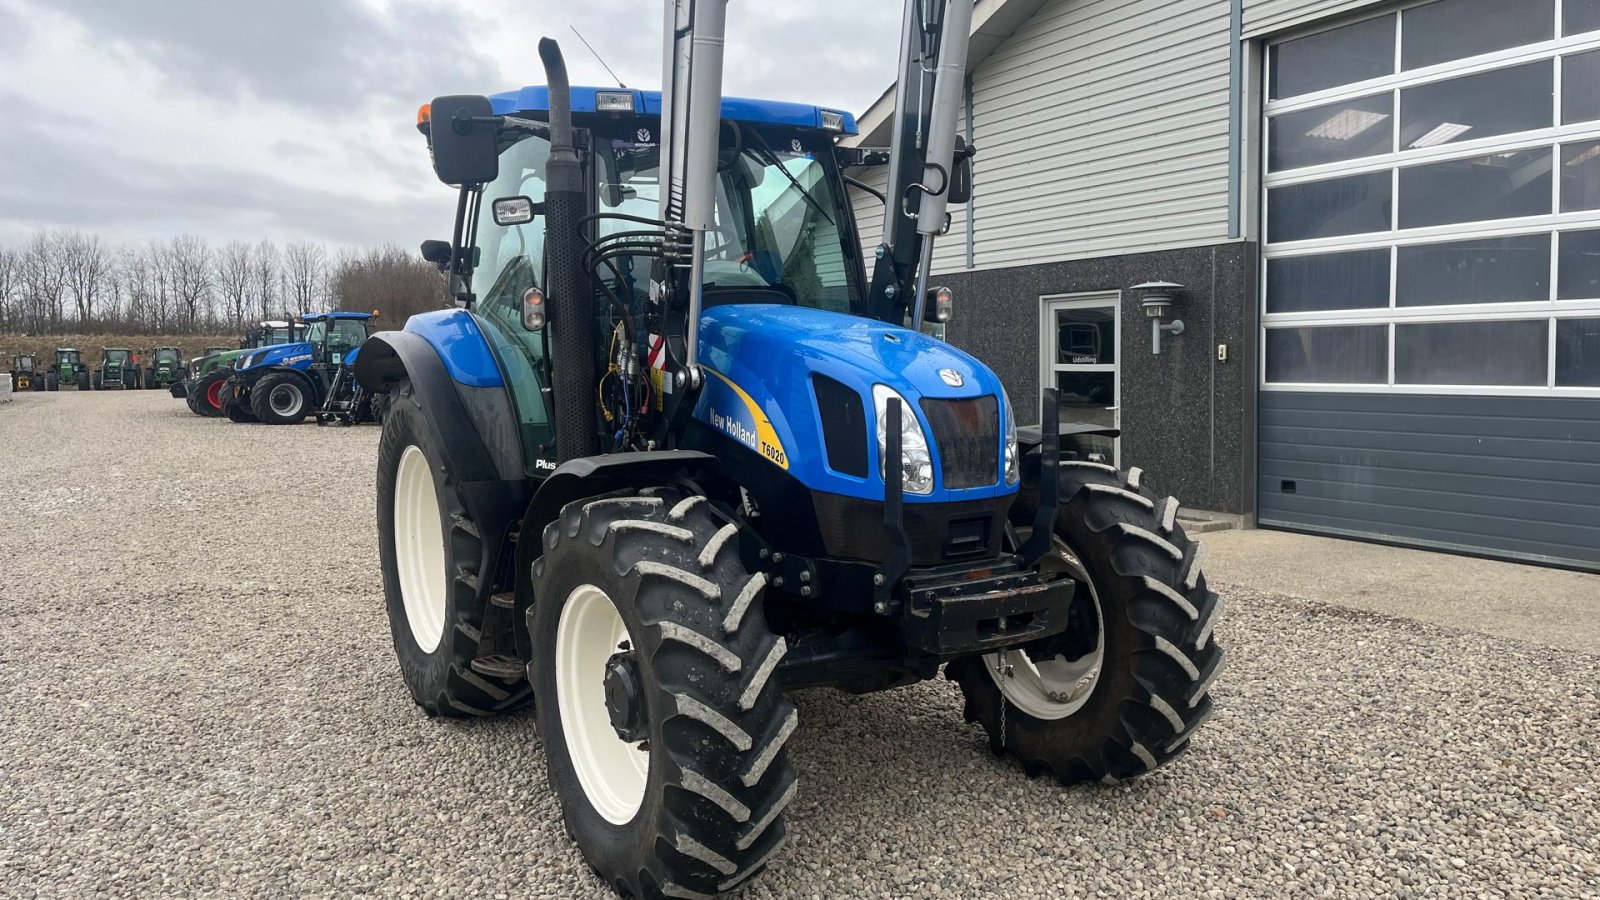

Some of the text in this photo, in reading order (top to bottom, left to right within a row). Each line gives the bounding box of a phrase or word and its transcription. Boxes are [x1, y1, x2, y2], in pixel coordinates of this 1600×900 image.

[709, 407, 756, 447] New Holland
[535, 459, 557, 470] Plus
[761, 441, 785, 465] T6020
